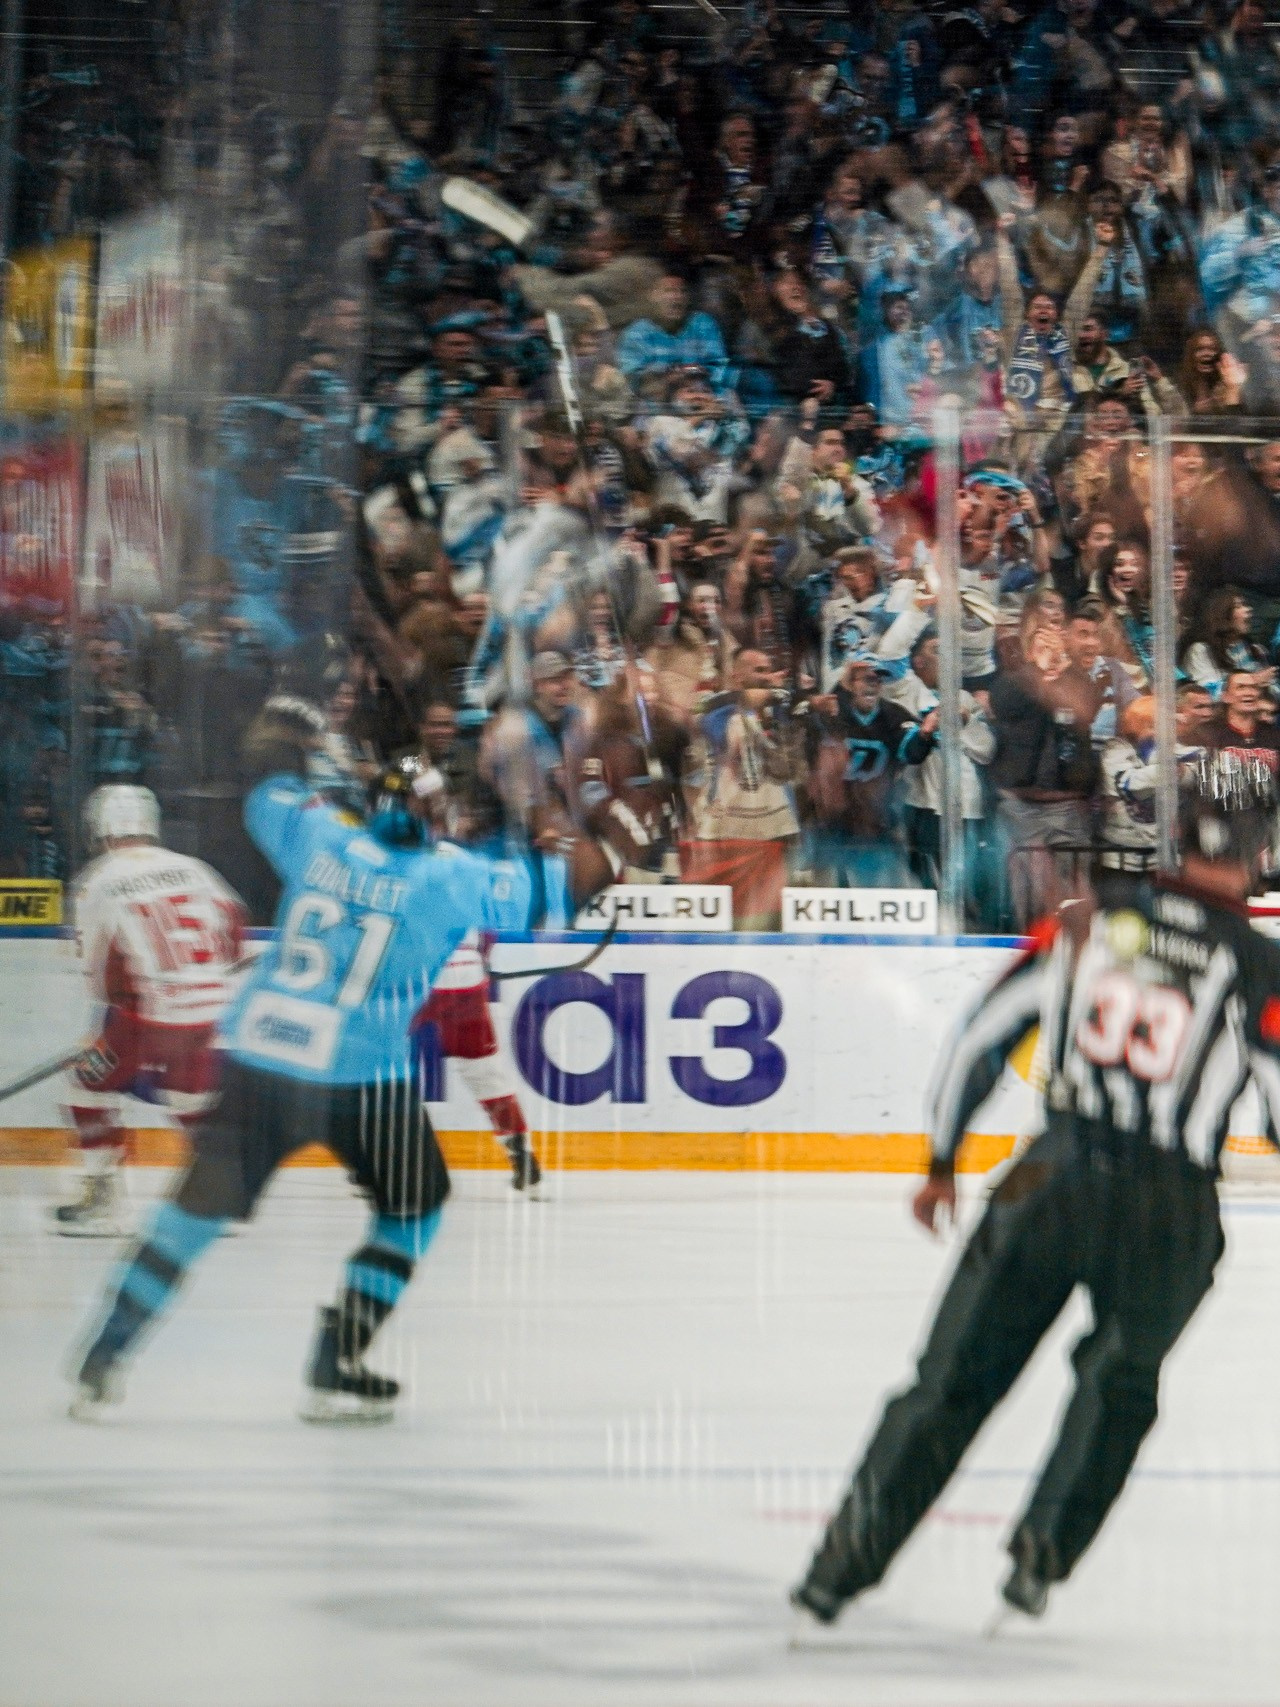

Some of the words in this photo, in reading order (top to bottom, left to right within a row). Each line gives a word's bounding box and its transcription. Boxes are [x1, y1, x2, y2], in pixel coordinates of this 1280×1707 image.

[587, 896, 722, 918] KHL.RU
[792, 899, 927, 922] KHL.RU
[274, 891, 396, 1010] 61
[1076, 970, 1192, 1083] 33
